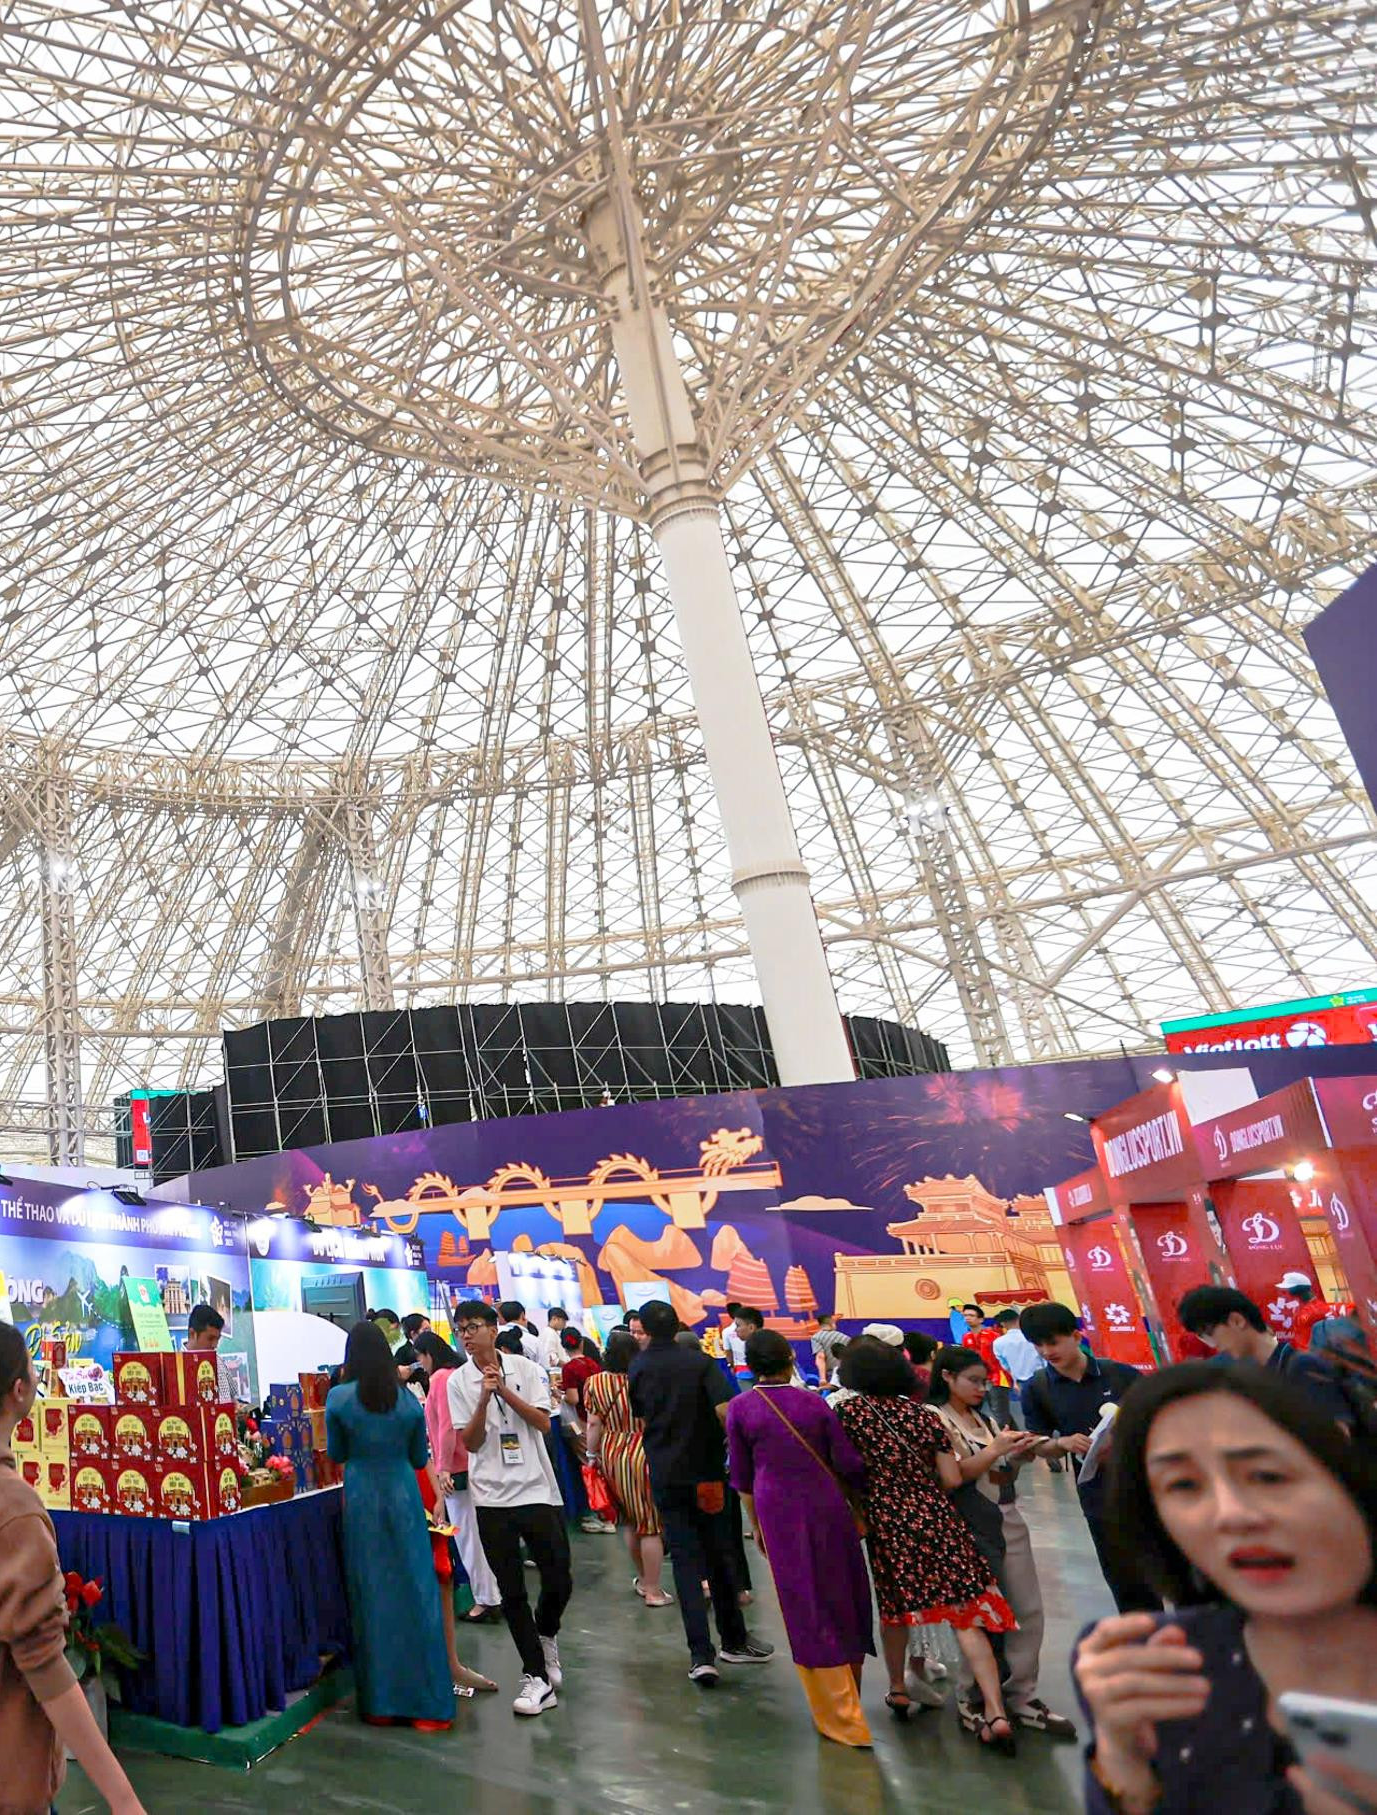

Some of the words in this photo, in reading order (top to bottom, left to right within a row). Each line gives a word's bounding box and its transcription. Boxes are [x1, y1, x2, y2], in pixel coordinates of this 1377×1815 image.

[1, 1195, 24, 1219] THỂ
[25, 1203, 54, 1224] THAO
[110, 1211, 140, 1233] THÀNH
[6, 1276, 43, 1304] ÒNG
